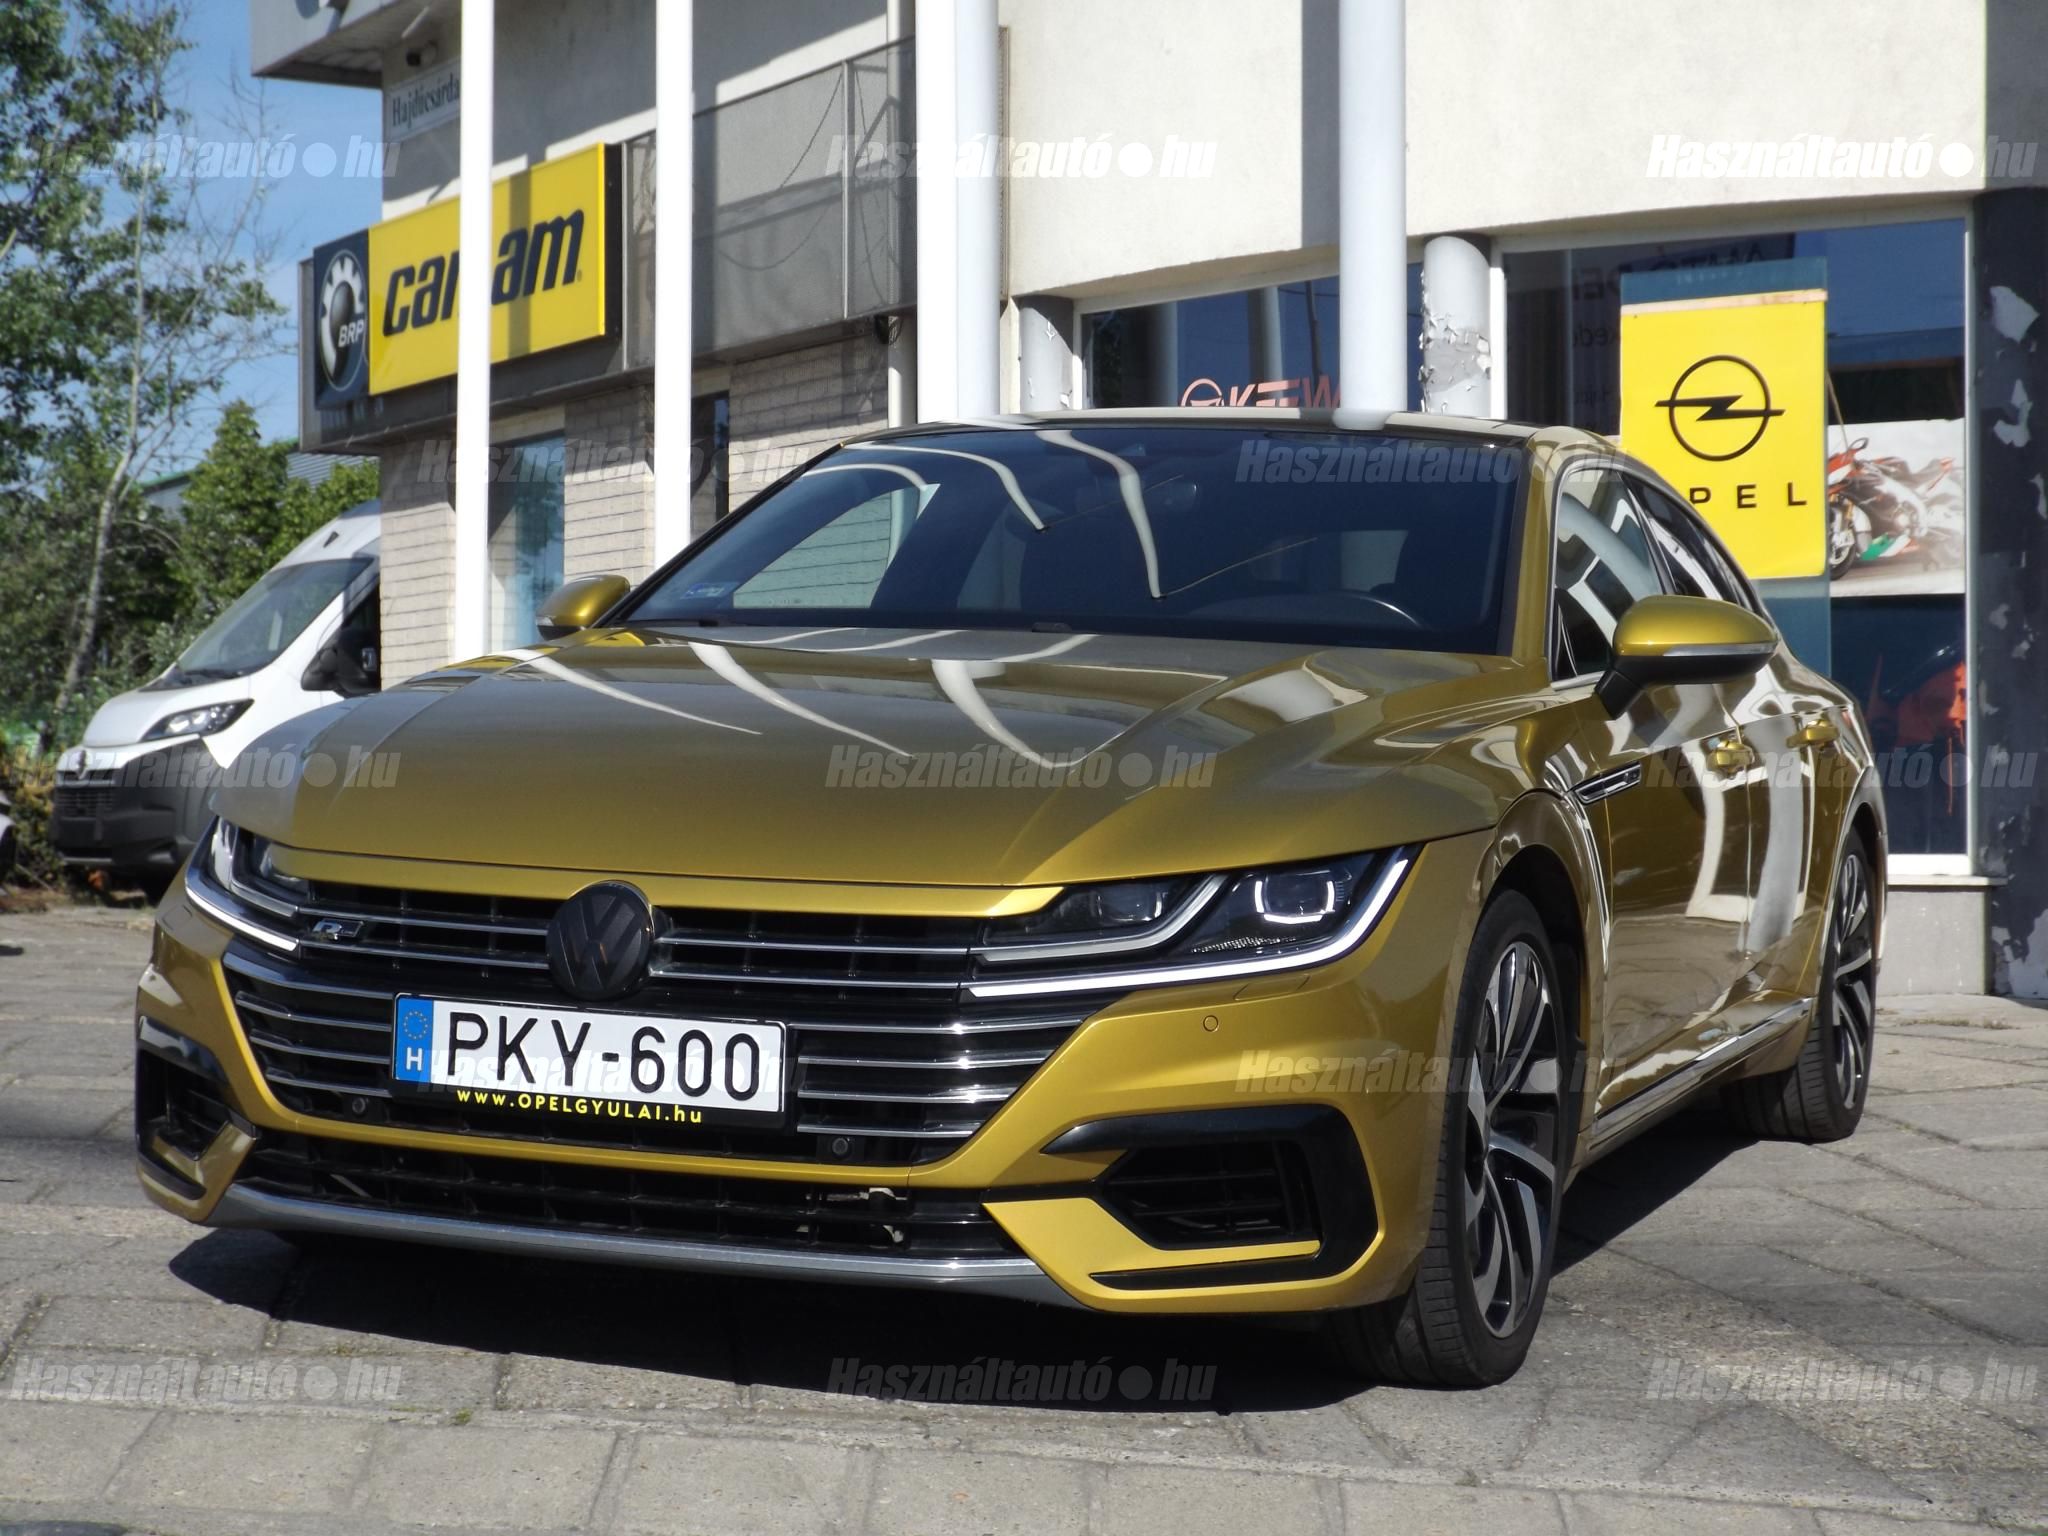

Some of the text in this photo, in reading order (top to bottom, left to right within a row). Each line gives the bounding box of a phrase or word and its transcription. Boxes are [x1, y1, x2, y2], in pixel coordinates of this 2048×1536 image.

[338, 320, 365, 348] BRP
[406, 1047, 423, 1072] H
[448, 1011, 760, 1101] PKY-600
[456, 1089, 702, 1124] www.OPELGYULAI.hu
